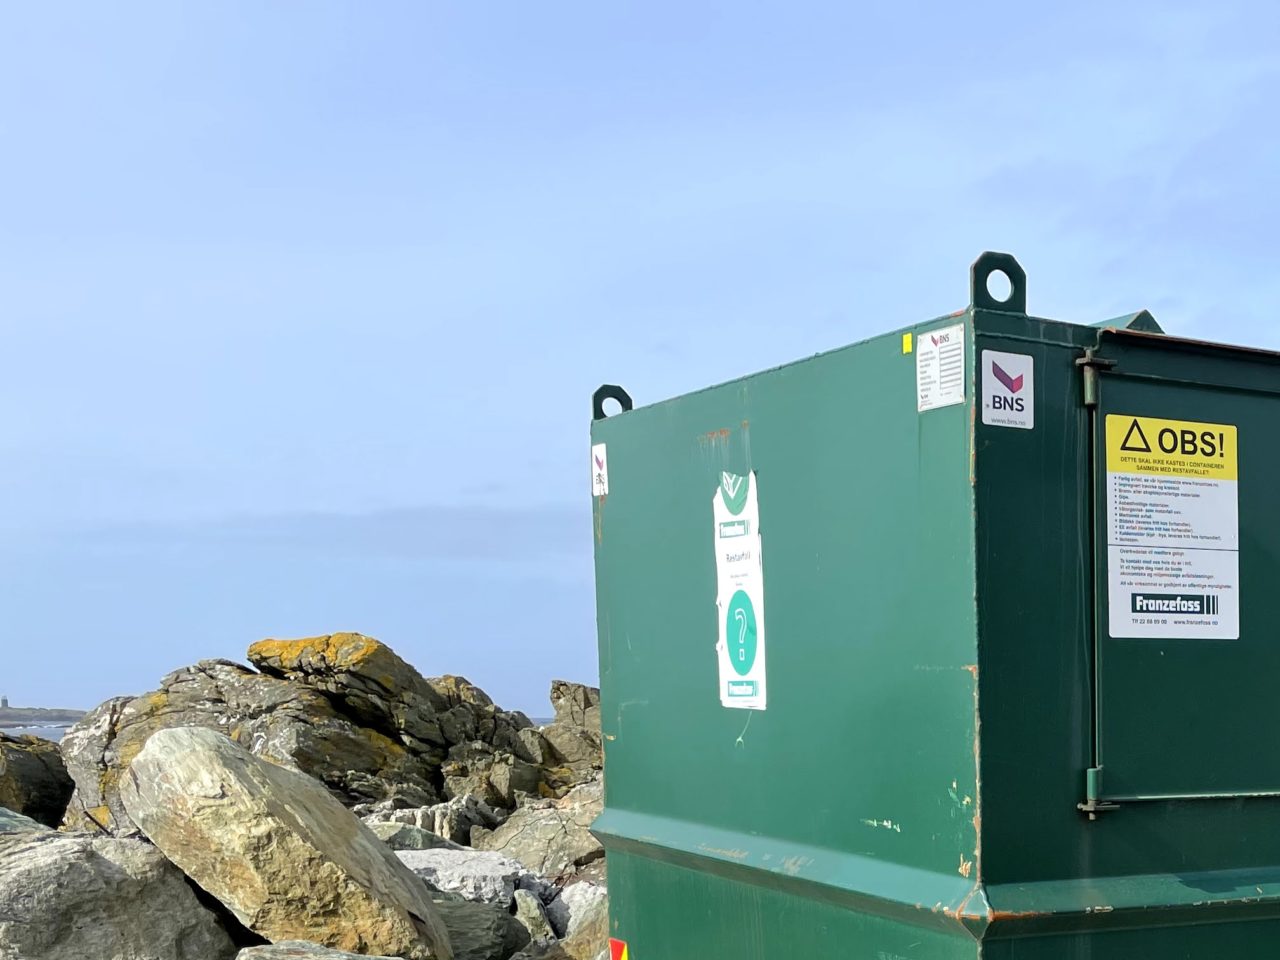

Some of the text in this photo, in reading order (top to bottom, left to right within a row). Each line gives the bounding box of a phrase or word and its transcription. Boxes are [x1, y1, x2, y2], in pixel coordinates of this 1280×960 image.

[992, 395, 1025, 412] BNS
[990, 418, 1026, 427] www.bns.no
[1157, 427, 1225, 458] OBS!
[1136, 596, 1201, 612] Franzefoss
